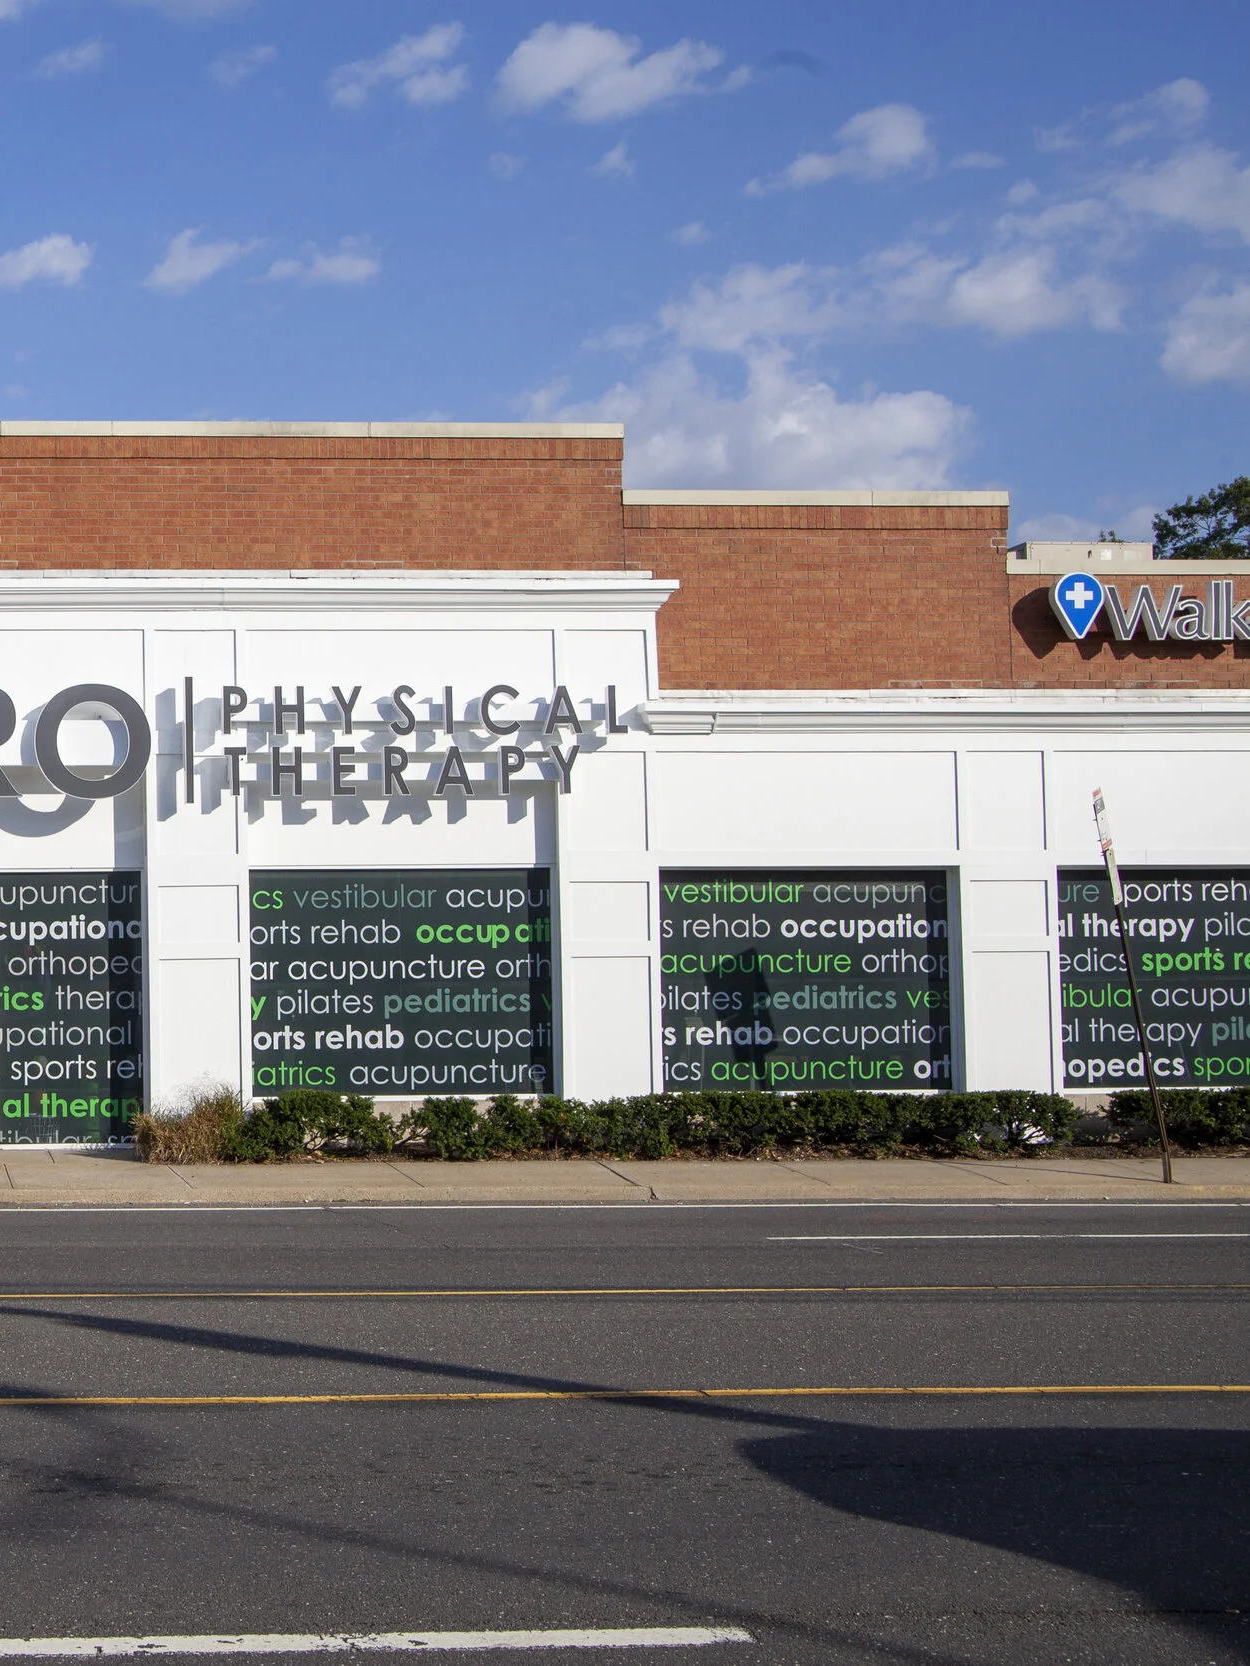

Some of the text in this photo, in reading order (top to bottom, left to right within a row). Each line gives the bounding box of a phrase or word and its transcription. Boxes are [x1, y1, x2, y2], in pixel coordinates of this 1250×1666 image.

[1104, 580, 1250, 641] Walk
[222, 685, 628, 736] PHYSICAL
[224, 744, 580, 796] THERAPY
[252, 884, 550, 913] cs vestibular acupu
[664, 878, 804, 903] vestibular
[1124, 878, 1193, 908] ports
[1201, 877, 1250, 902] reh
[250, 920, 301, 945] orts
[311, 919, 401, 944] rehab
[683, 914, 771, 938] rehab
[780, 914, 949, 944] occupation
[1082, 913, 1195, 942] therapy
[288, 954, 485, 985] acupuncture
[660, 948, 852, 978] acupuncture
[1141, 947, 1225, 977] sports
[55, 985, 141, 1012] thera
[277, 989, 374, 1020] pilates
[384, 988, 531, 1019] pediatrics
[753, 985, 898, 1015] pediatrics
[1151, 987, 1250, 1012] acupu
[253, 1025, 306, 1051] orts
[315, 1024, 405, 1049] rehab
[686, 1021, 773, 1046] rehab
[1212, 1016, 1250, 1047] pil
[11, 1055, 97, 1085] sports
[350, 1059, 547, 1090] acupuncture
[711, 1055, 903, 1085] acupuncture
